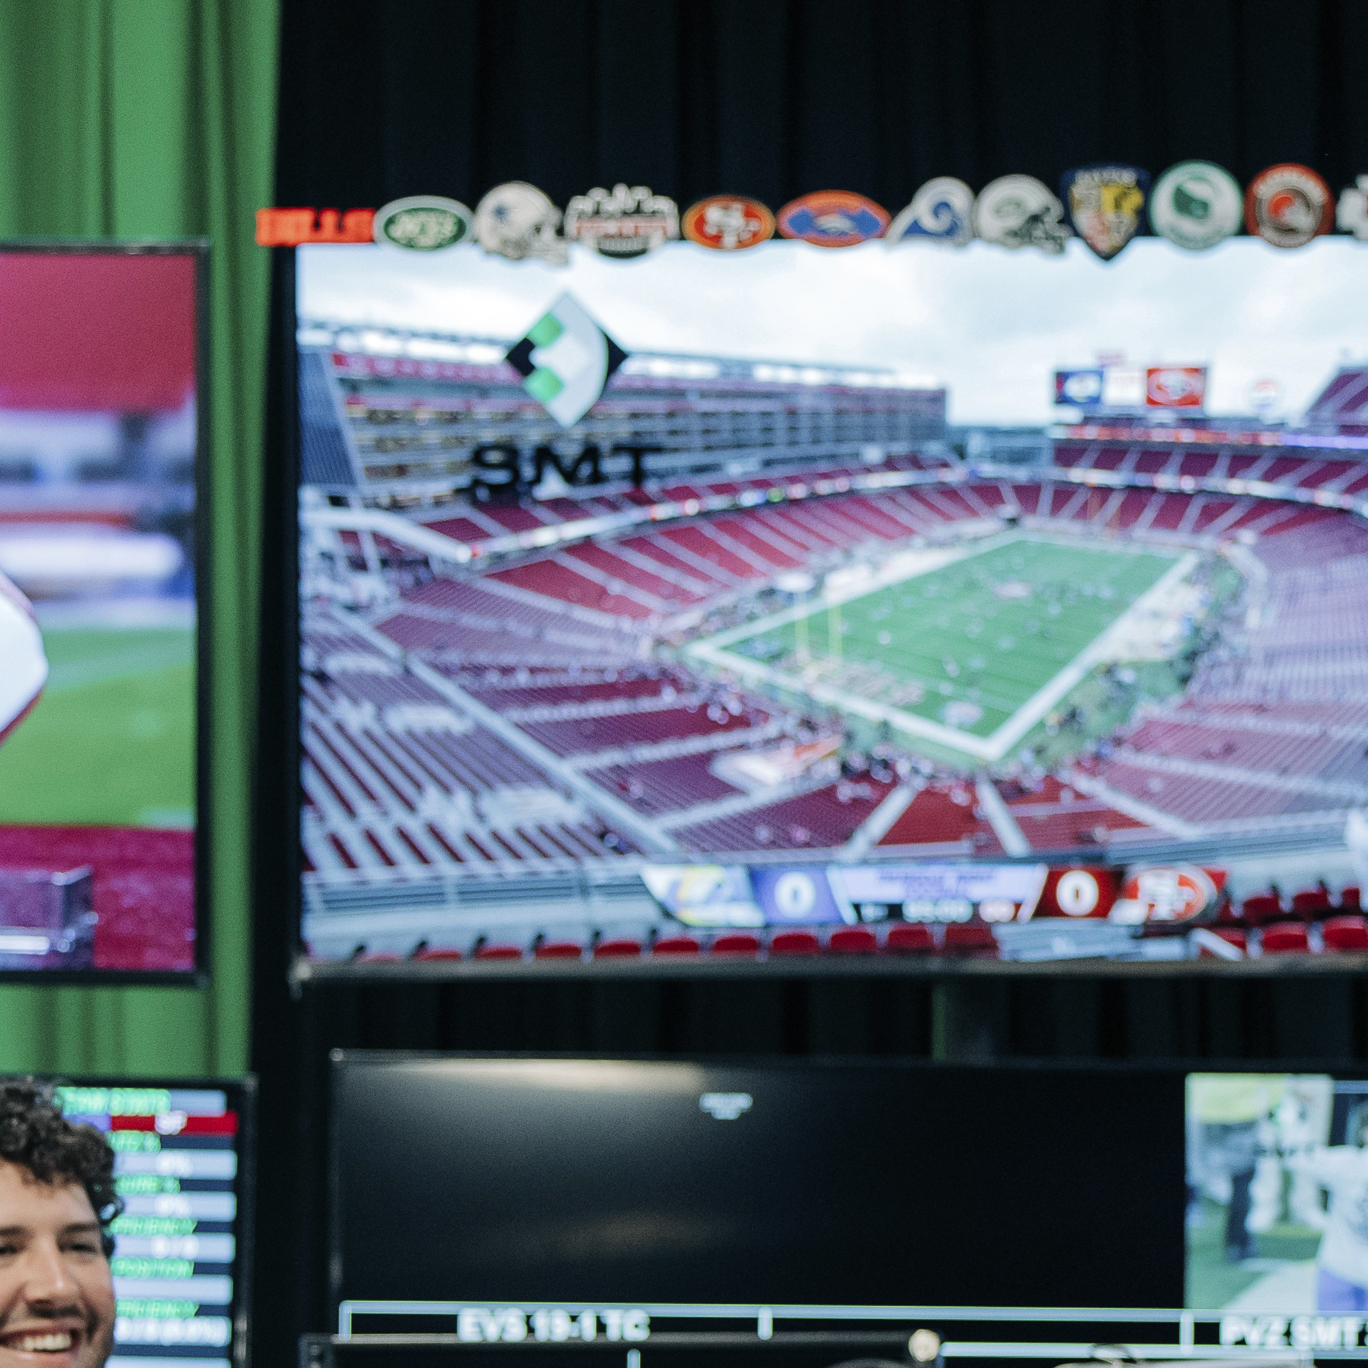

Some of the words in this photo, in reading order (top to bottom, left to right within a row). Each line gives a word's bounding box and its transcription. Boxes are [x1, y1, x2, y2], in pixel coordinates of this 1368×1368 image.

[469, 444, 663, 496] SMT
[774, 871, 817, 919] 0
[1056, 869, 1099, 917] 0
[457, 1307, 527, 1342] EVS
[600, 1308, 650, 1342] TC
